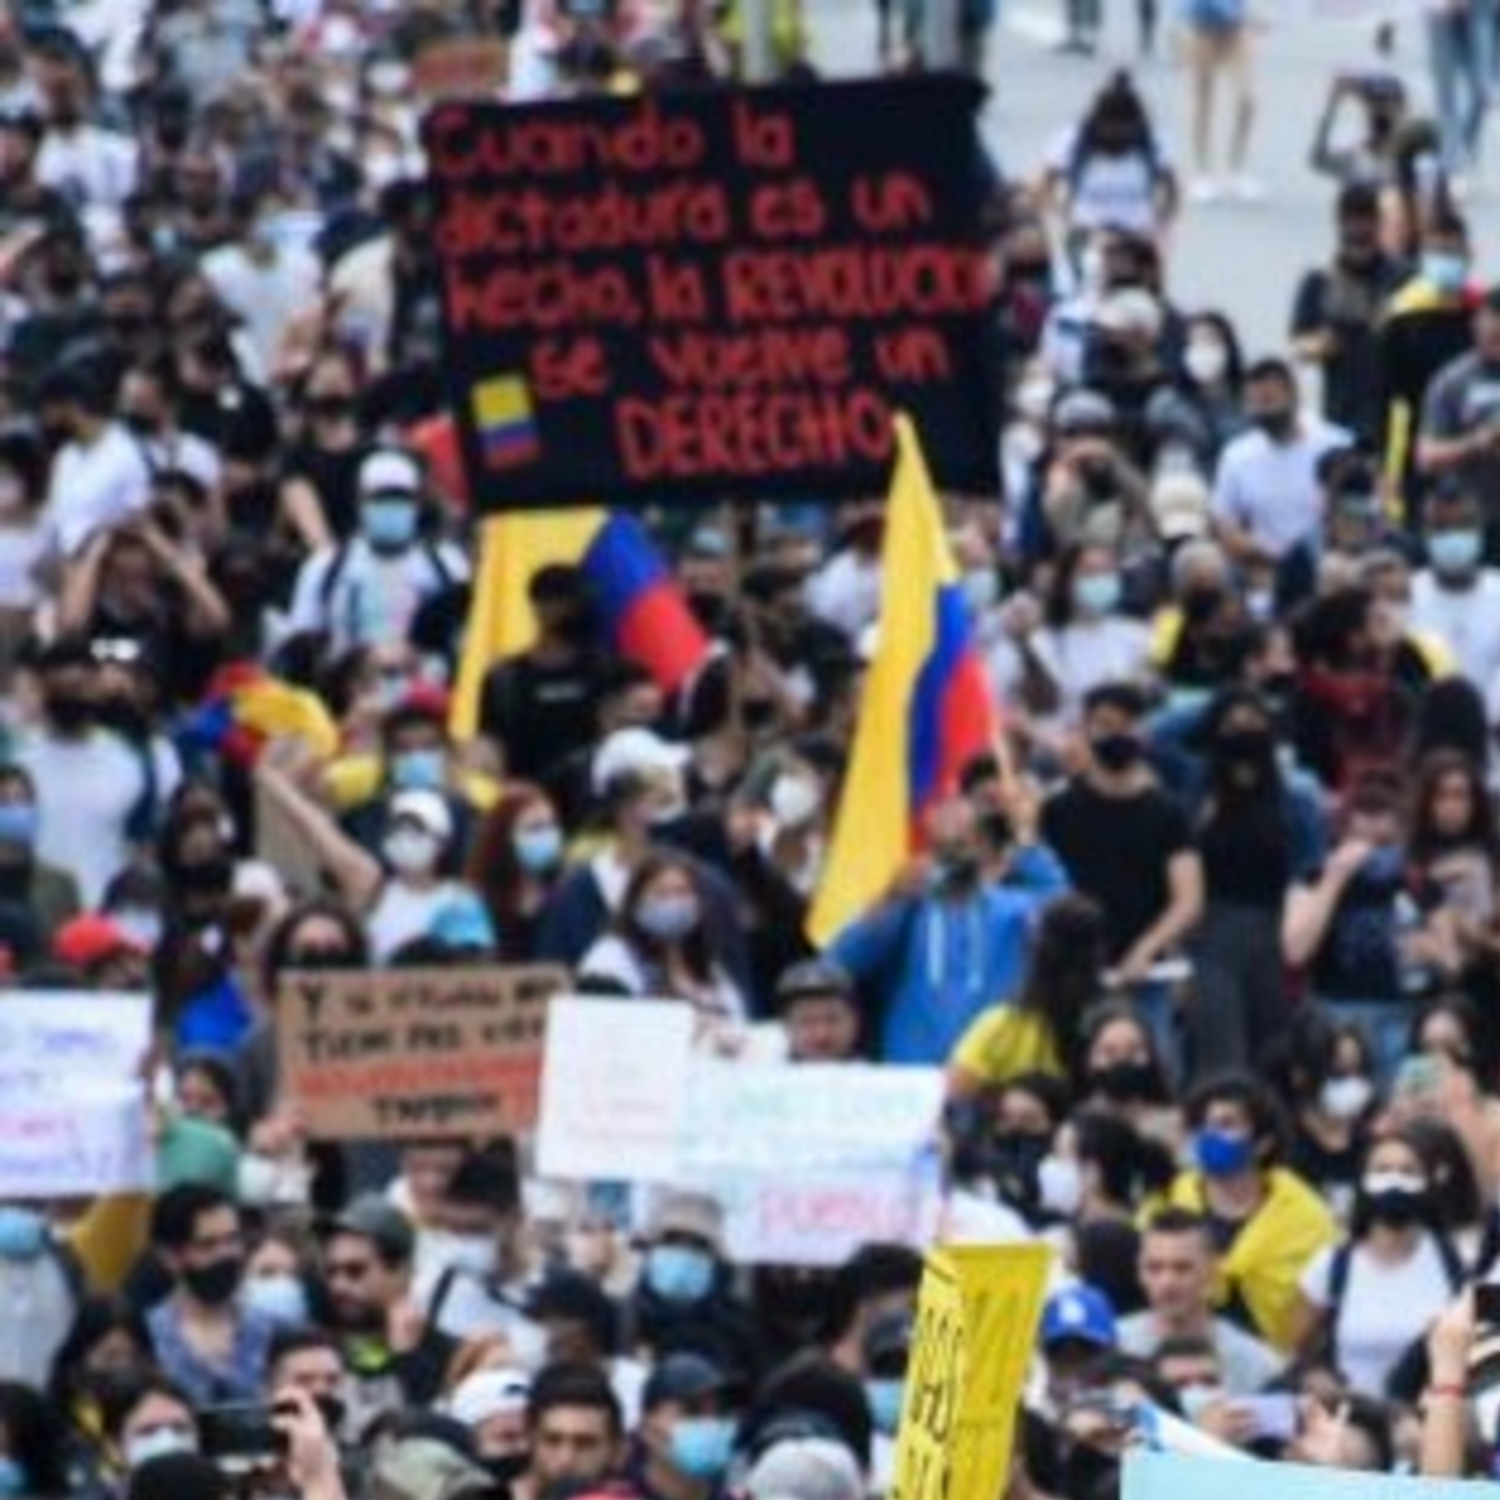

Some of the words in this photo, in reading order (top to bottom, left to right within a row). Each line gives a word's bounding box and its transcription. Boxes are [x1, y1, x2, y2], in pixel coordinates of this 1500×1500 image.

[434, 97, 705, 176] Cuando
[735, 98, 796, 169] la
[438, 178, 728, 254] dictadura
[750, 179, 825, 236] es
[851, 173, 932, 230] un
[648, 254, 705, 319] la
[531, 338, 610, 398] se
[650, 327, 850, 384] vuelve
[876, 327, 950, 381] un
[613, 387, 892, 479] DERECHO
